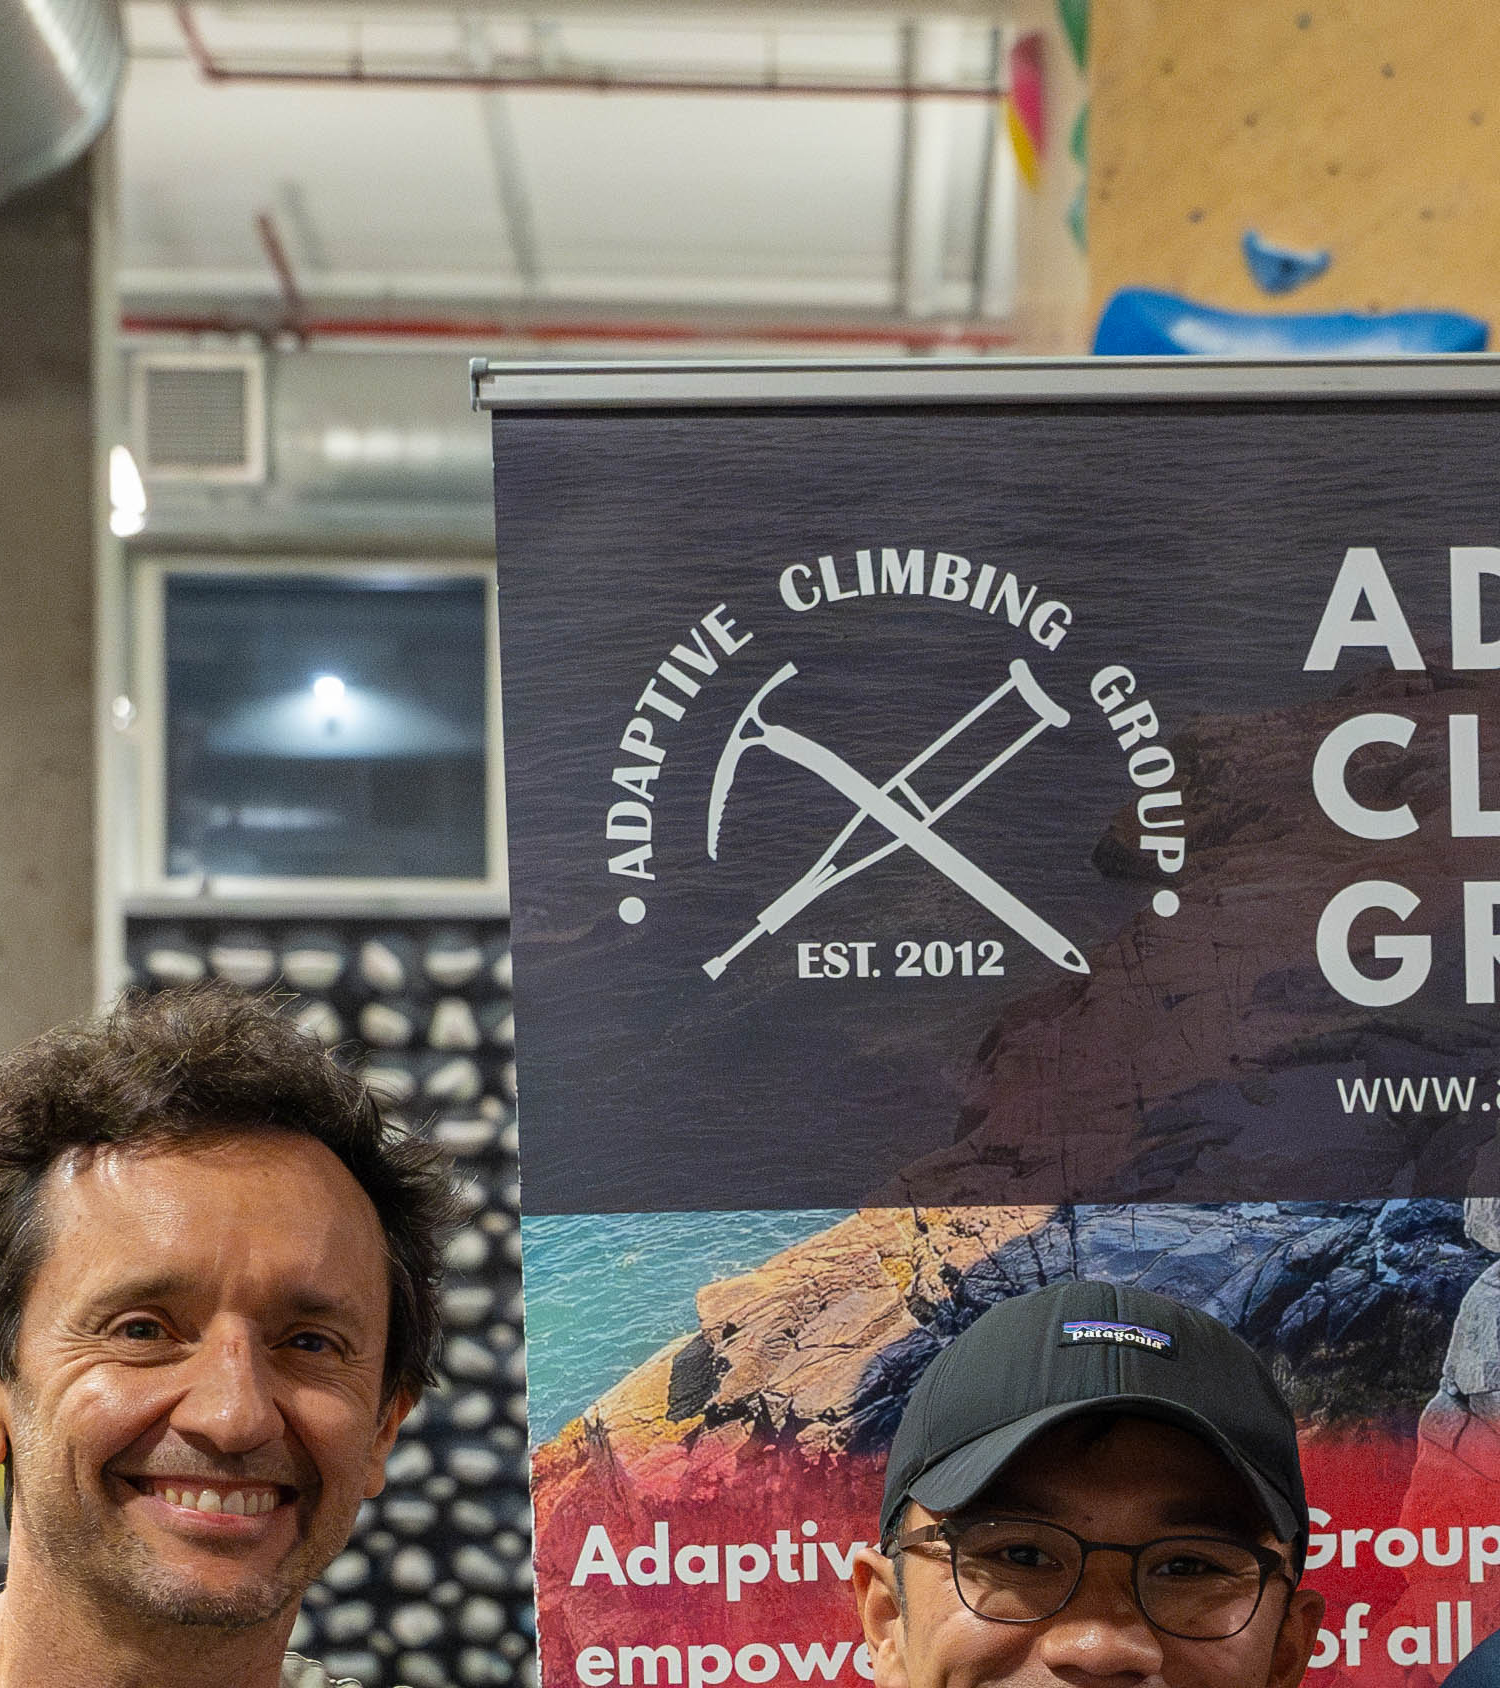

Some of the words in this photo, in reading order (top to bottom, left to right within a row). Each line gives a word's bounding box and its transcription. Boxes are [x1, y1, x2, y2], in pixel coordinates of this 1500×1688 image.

[779, 548, 1073, 651] CLIMBING
[606, 603, 754, 880] ADAPTIVE
[1089, 664, 1185, 873] GROUP
[798, 941, 880, 978] EST.
[895, 940, 1005, 977] 2012
[1071, 1327, 1163, 1351] patagonia
[570, 1519, 882, 1602] Adaptiv
[1307, 1601, 1372, 1668] of
[1387, 1600, 1473, 1666] all
